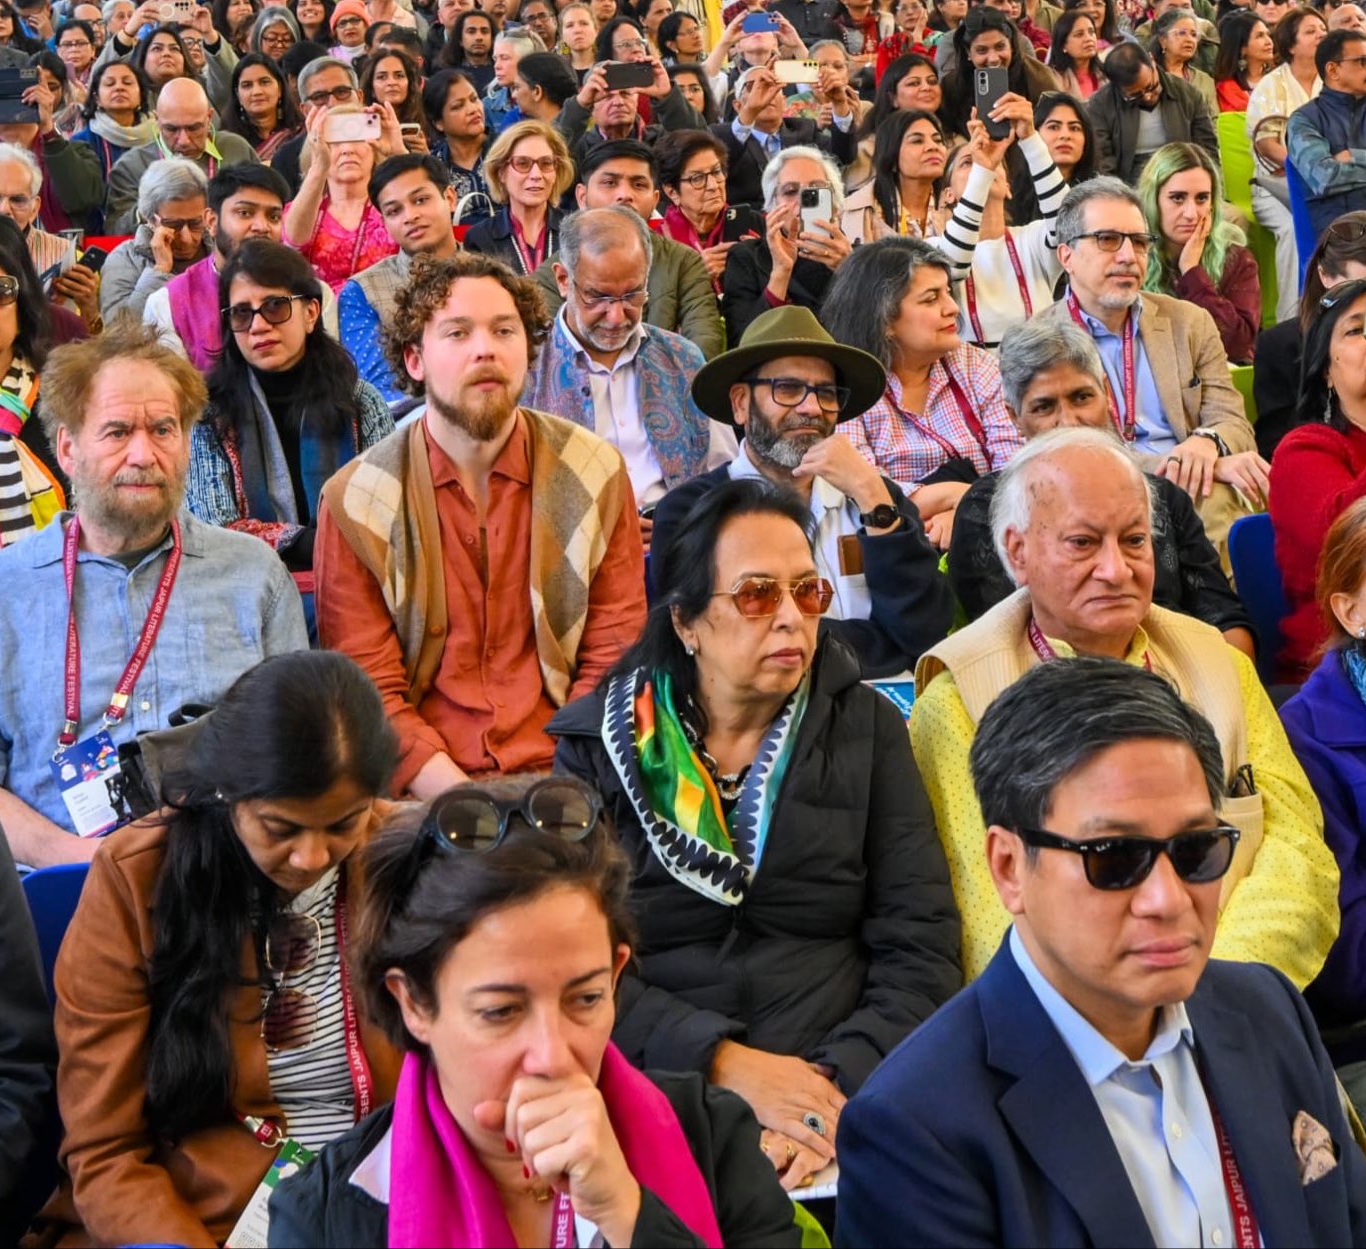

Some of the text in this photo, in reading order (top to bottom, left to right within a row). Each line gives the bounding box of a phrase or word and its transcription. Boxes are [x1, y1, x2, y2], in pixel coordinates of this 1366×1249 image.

[156, 586, 169, 612] JAIPUR
[138, 611, 160, 657] LITERATURE
[67, 676, 77, 715] FESTIVAL
[119, 656, 141, 695] FESTIVAL
[348, 1031, 364, 1072] JAIPUR
[358, 1074, 371, 1120] ESENTS
[1226, 1159, 1249, 1211] JAIPUR
